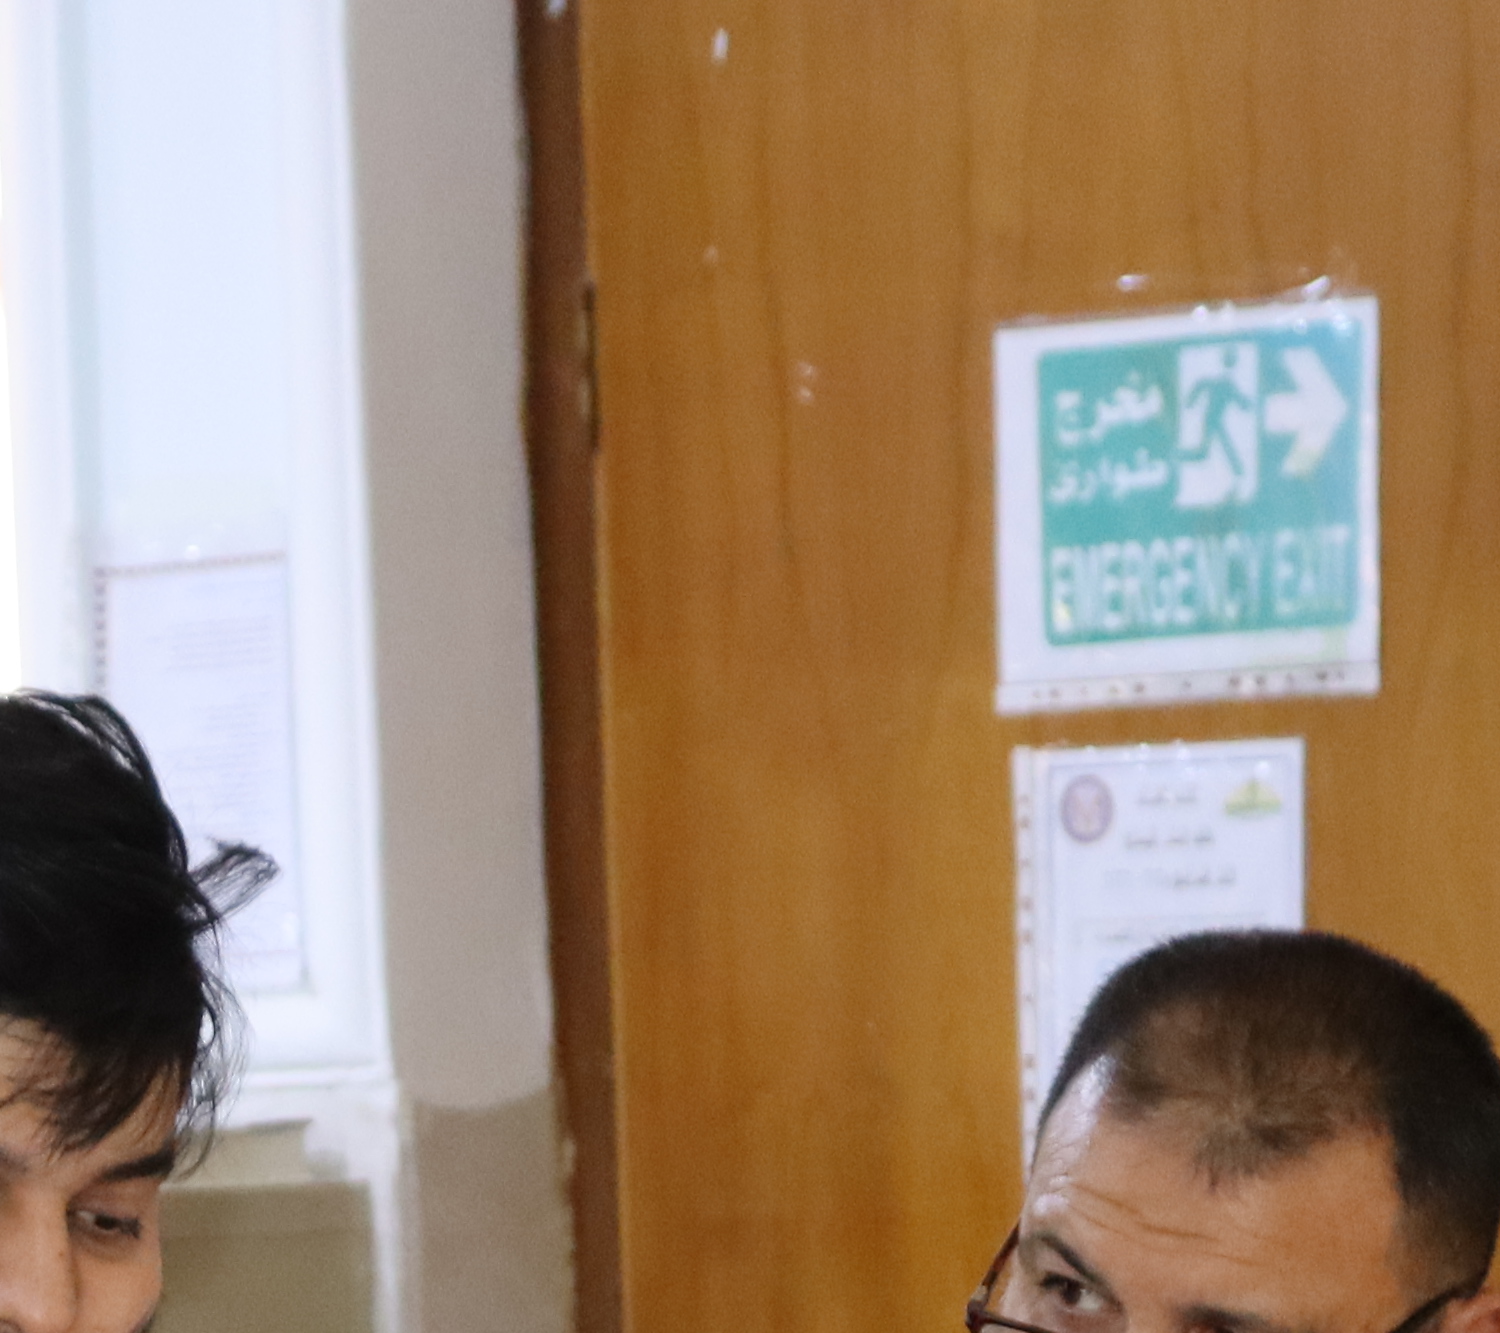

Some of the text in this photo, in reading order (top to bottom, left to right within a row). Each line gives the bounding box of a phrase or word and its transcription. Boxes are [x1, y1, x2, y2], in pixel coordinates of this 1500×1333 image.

[1054, 370, 1166, 446] مخرج
[1050, 525, 1351, 632] EMERGENCY EXIT
